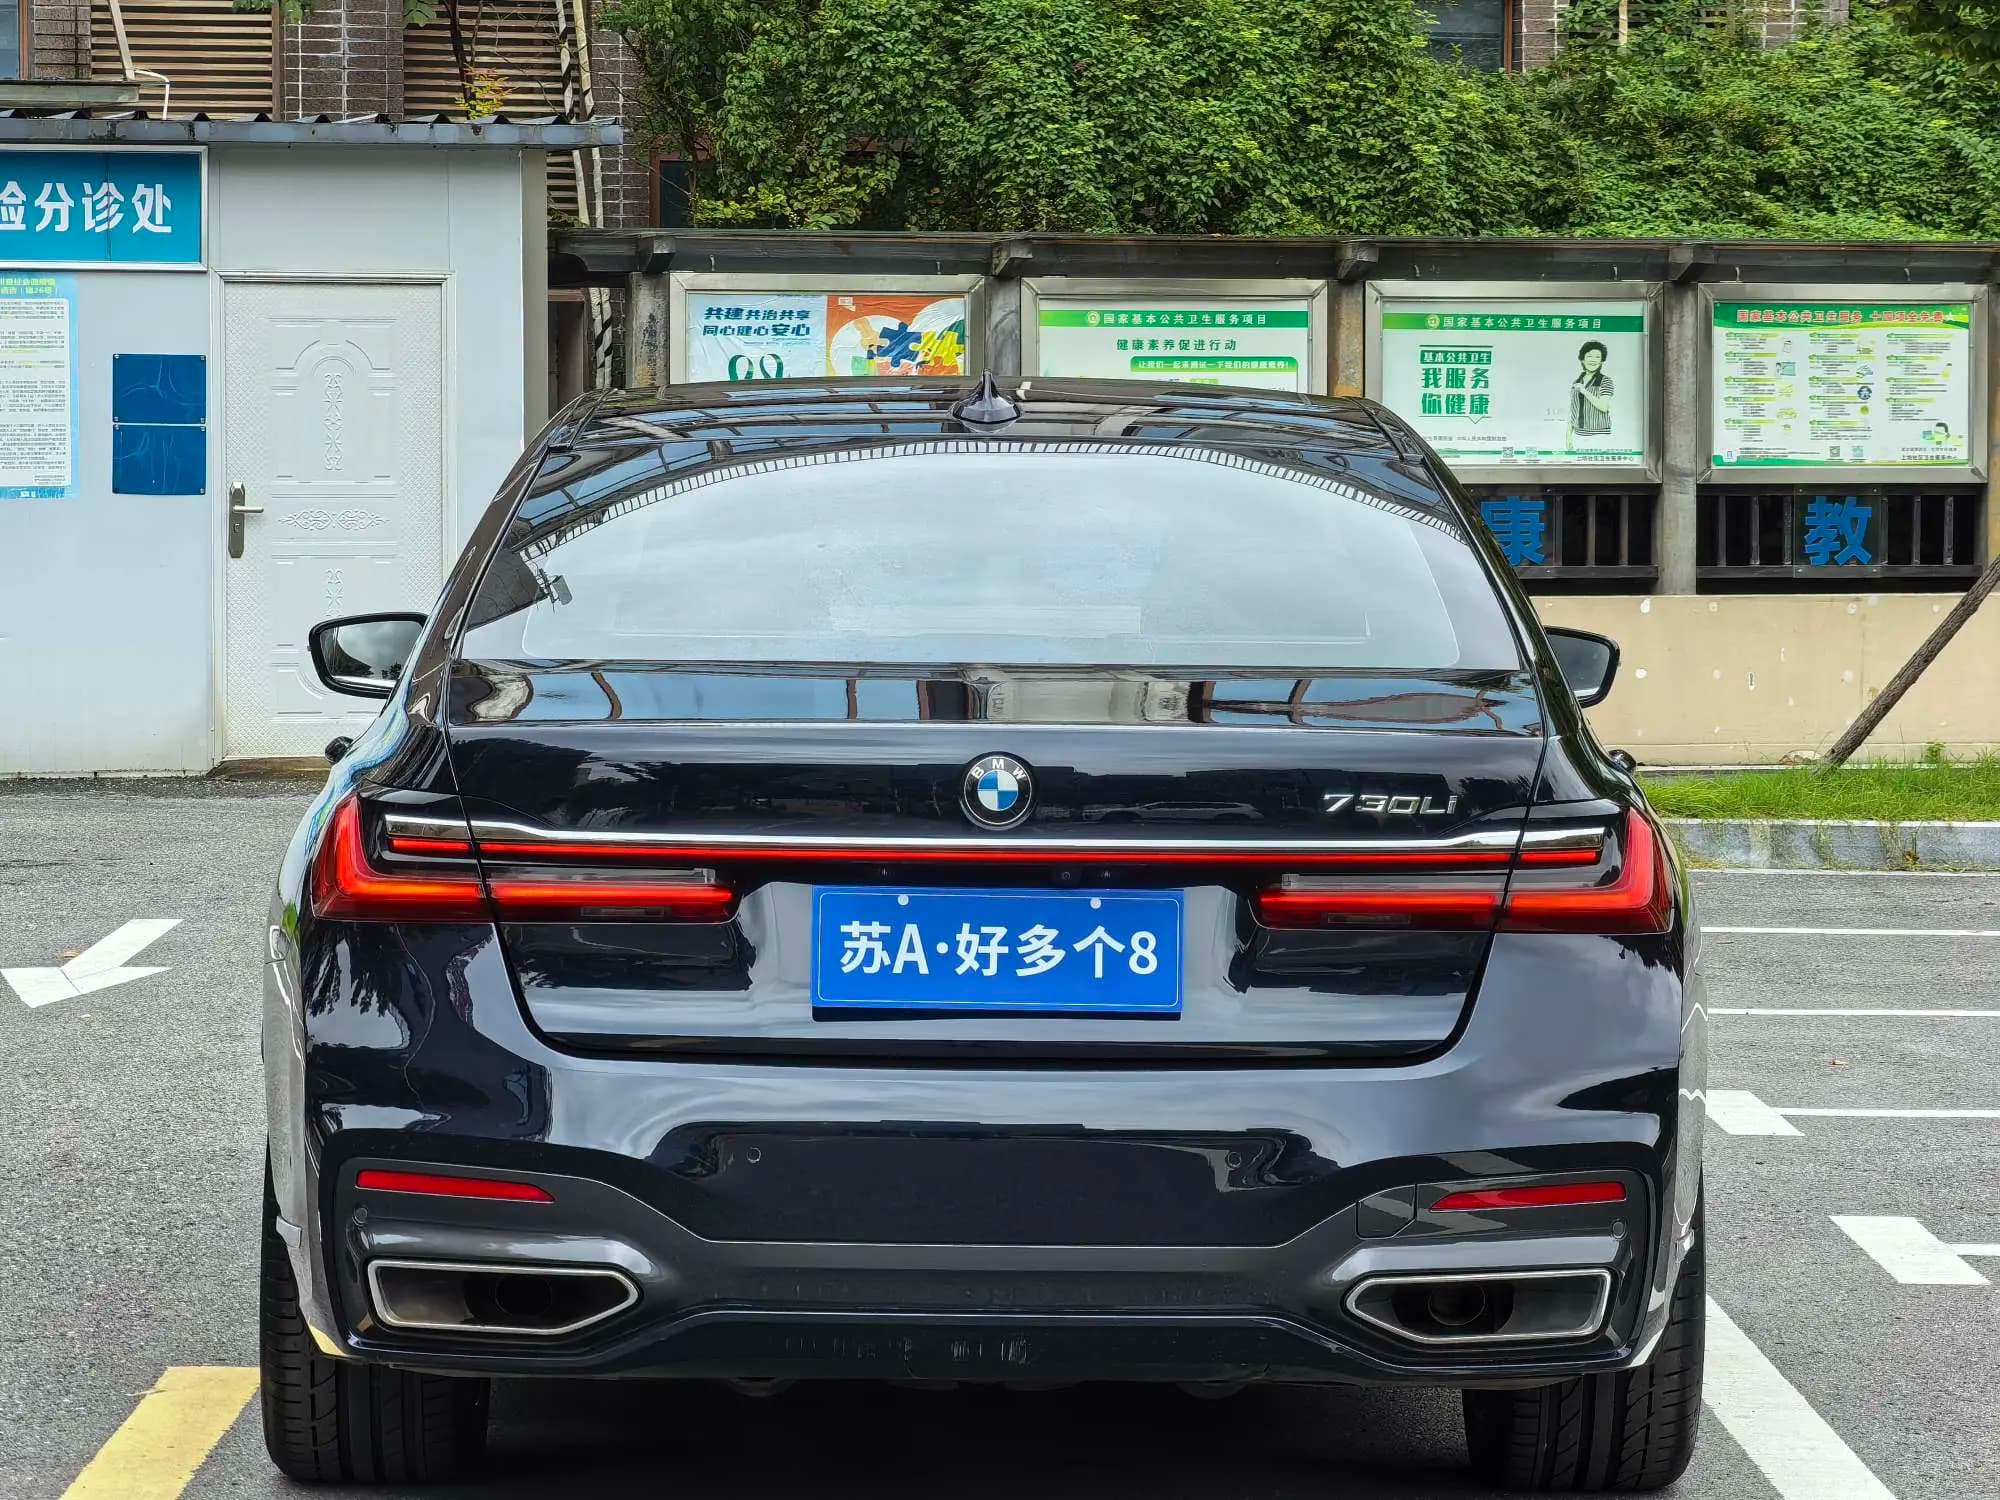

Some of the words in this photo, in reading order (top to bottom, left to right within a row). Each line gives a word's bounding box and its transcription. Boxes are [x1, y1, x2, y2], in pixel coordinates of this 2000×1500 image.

[703, 306, 812, 321] 共建共治共享
[1102, 313, 1268, 326] 国家基本公共卫生服务项目
[1736, 309, 1863, 323] 国家基本公共卫生服务
[702, 322, 811, 337] 同心健心安心
[1442, 316, 1602, 329] 国家基本公共卫生服务项目
[1116, 338, 1238, 351] 健康素养促进行动
[1422, 350, 1492, 363] 基本公共卫生
[1420, 367, 1490, 389] 我服务
[1420, 392, 1491, 415] 你健康
[1480, 495, 1545, 565] 康
[1803, 495, 1873, 566] 教
[971, 758, 1027, 780] BMW
[1323, 794, 1458, 815] 730Li
